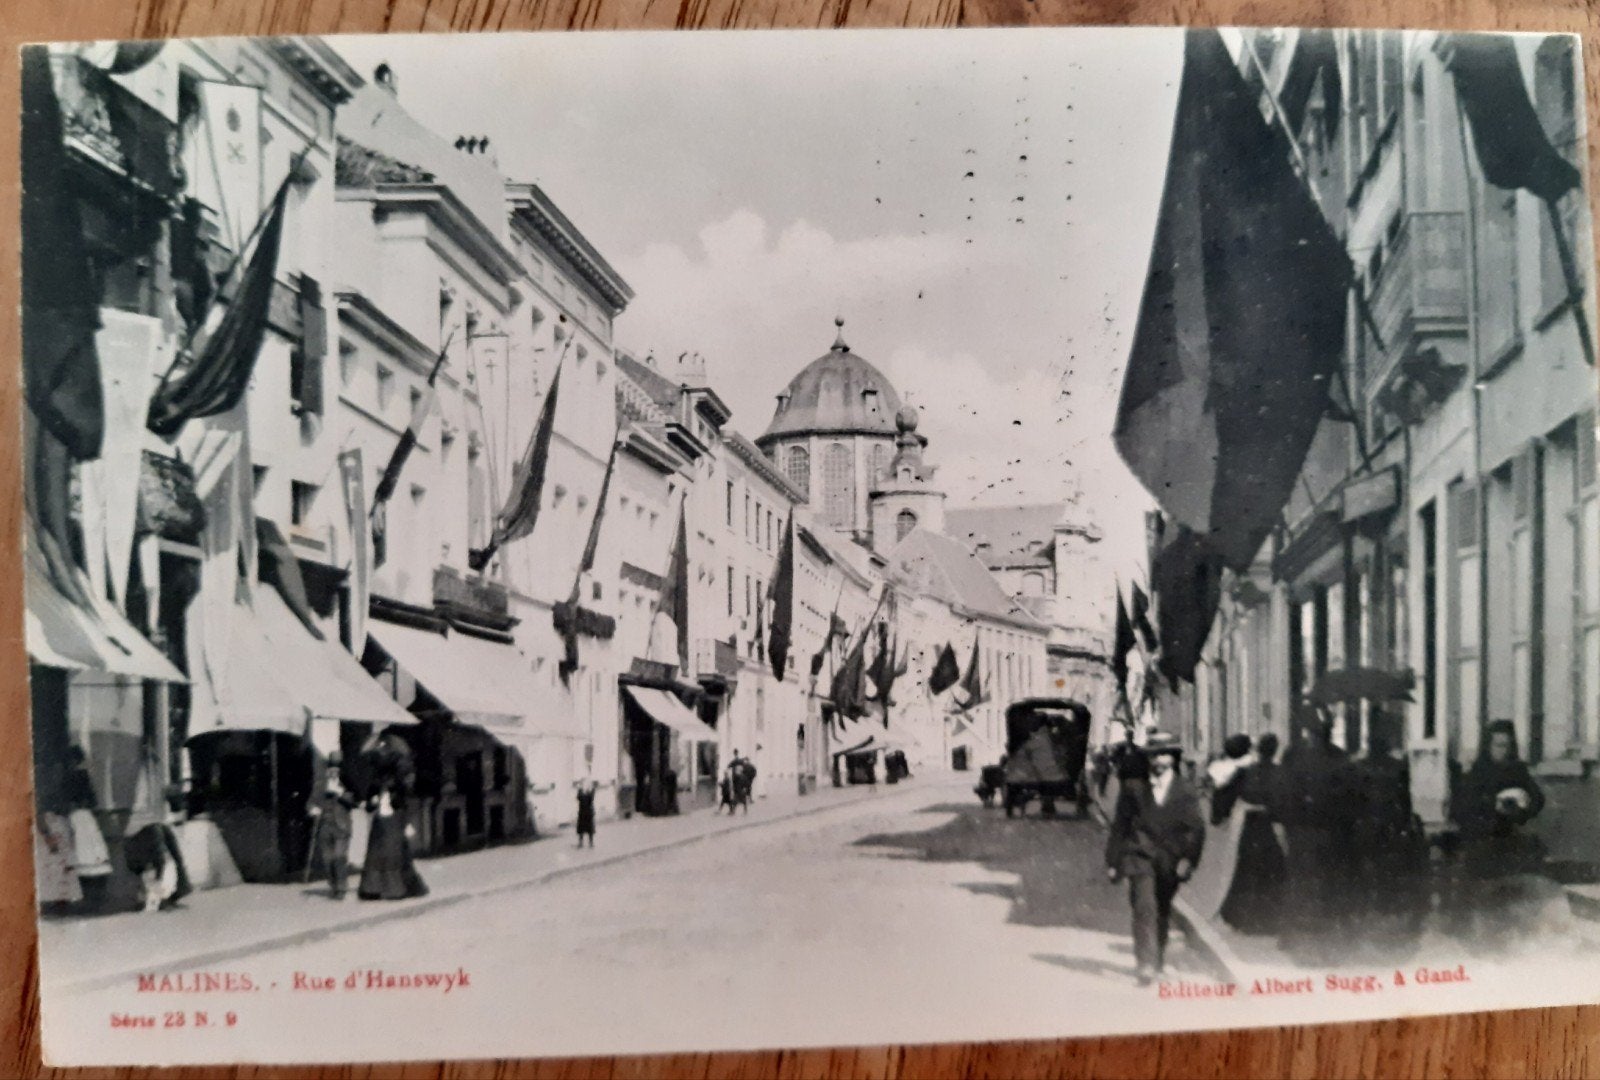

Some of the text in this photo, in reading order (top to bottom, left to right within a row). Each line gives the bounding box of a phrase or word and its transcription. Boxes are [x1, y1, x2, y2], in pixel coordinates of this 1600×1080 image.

[137, 971, 261, 993] MALINES.
[293, 971, 336, 990] Rue
[344, 966, 471, 994] d'Hanswyk
[1158, 982, 1237, 998] Editeur
[1250, 977, 1314, 995] Albert
[1415, 964, 1471, 985] Gand.
